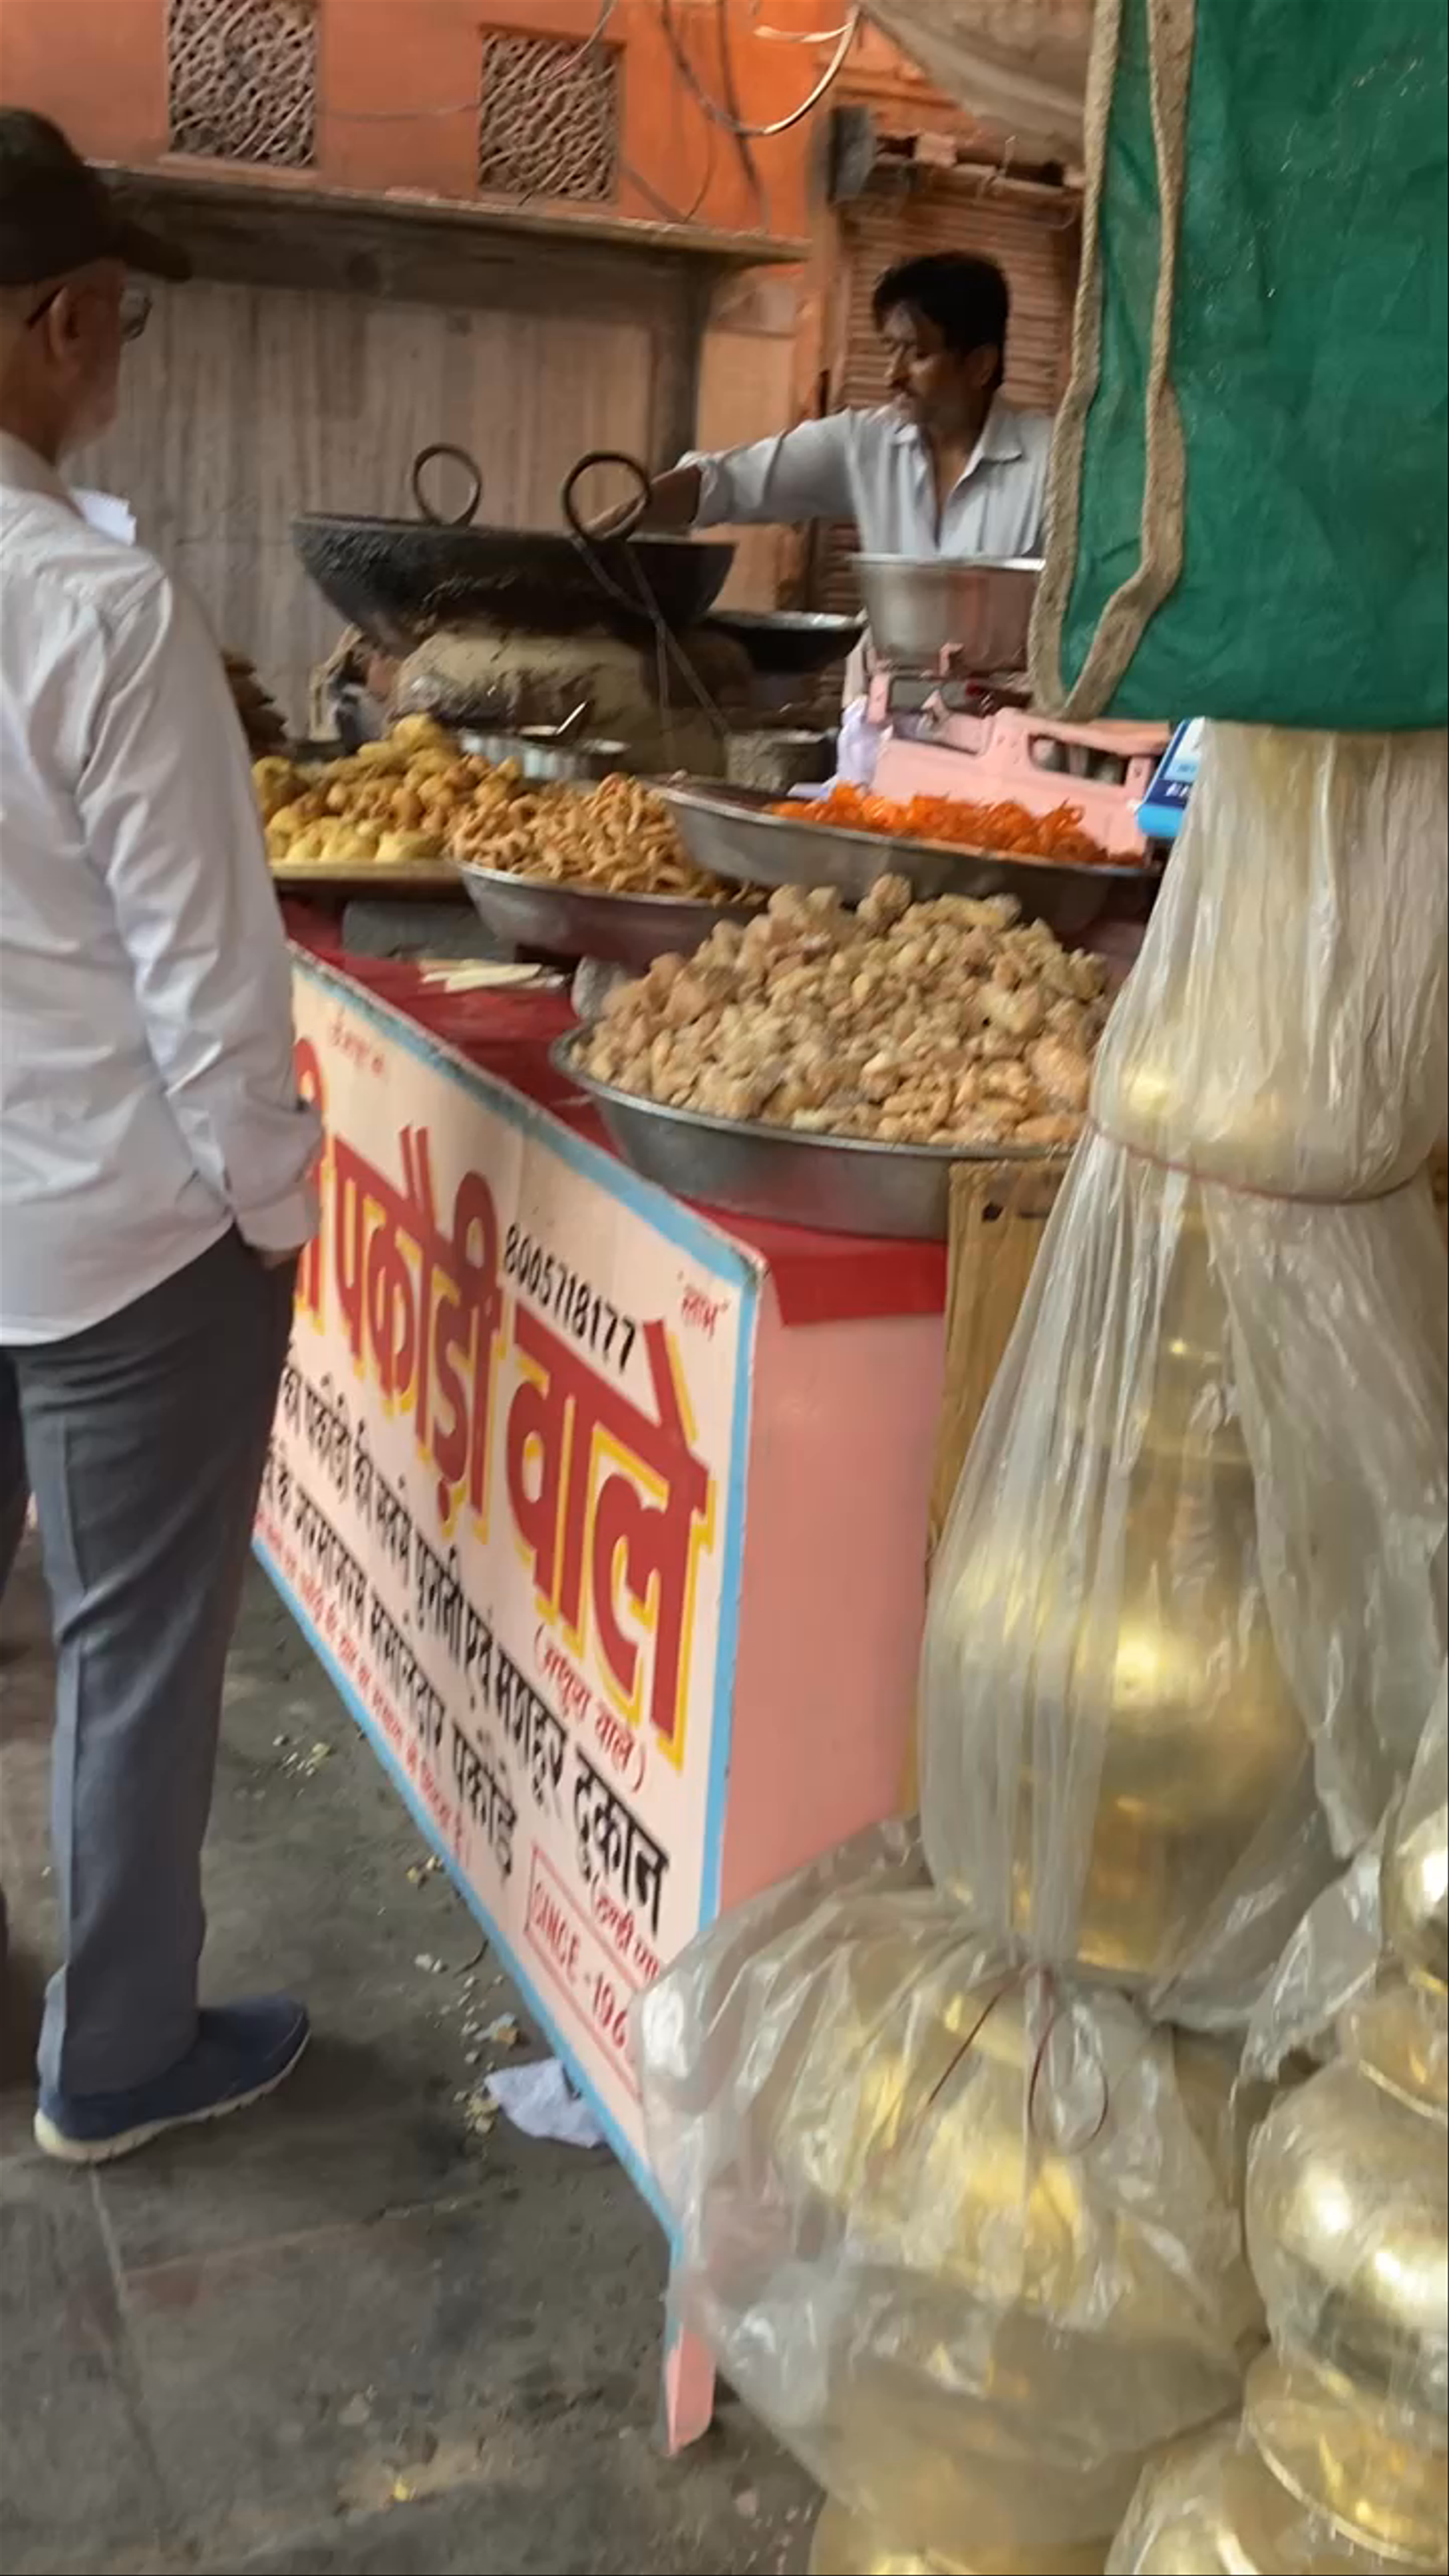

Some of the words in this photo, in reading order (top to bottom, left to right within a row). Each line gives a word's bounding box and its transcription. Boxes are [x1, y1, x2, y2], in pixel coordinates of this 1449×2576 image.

[332, 1124, 508, 1541] पकौड़ी
[504, 1316, 715, 1772] वाले
[504, 1222, 637, 1376] 8005718177
[497, 1638, 568, 1811] मशहूर
[575, 1745, 670, 1939] दुकान
